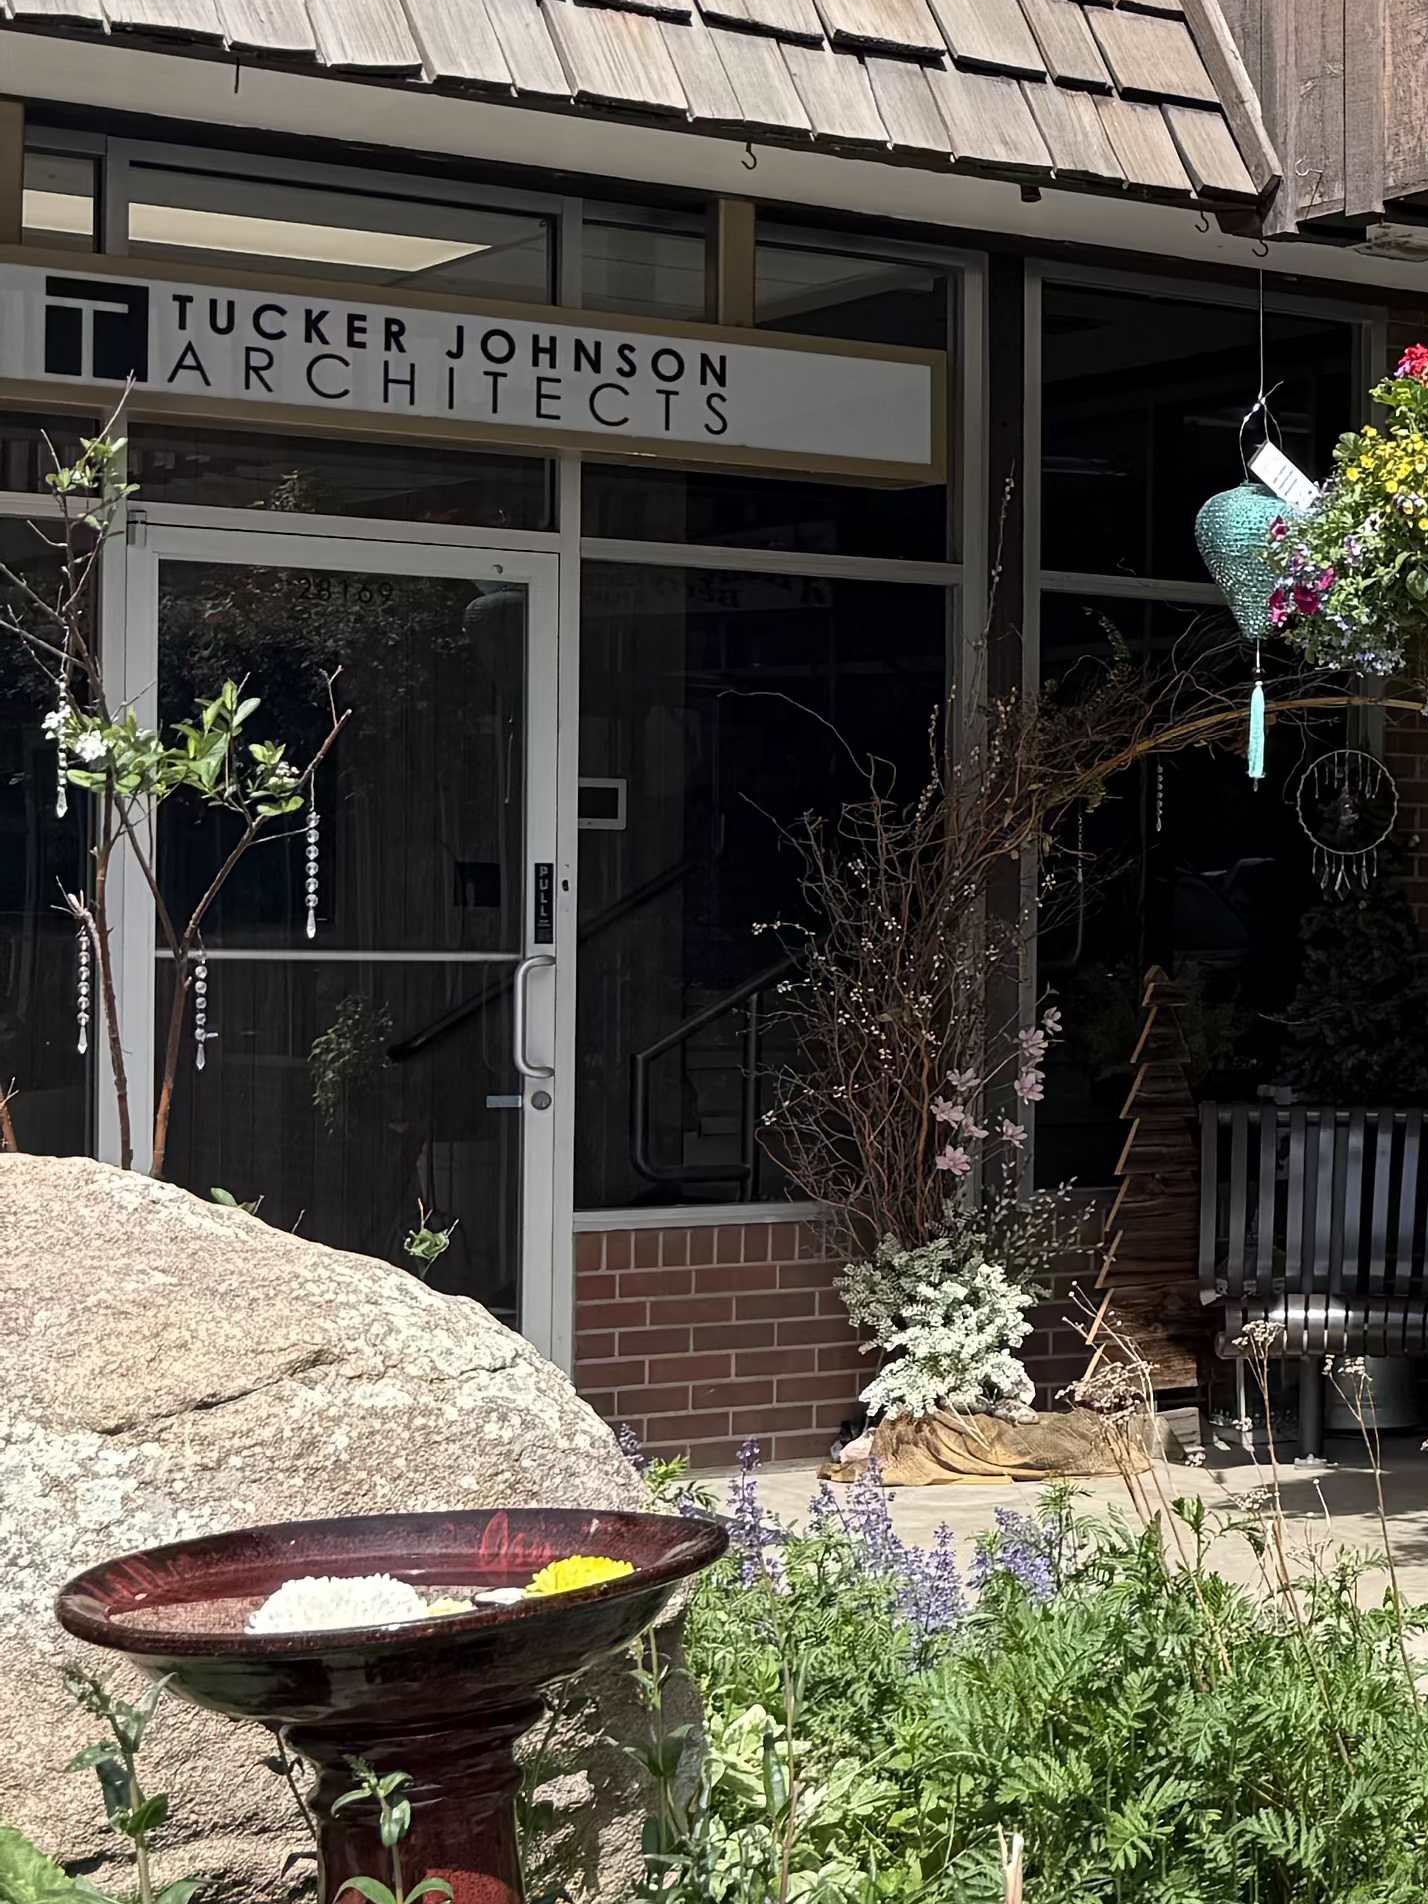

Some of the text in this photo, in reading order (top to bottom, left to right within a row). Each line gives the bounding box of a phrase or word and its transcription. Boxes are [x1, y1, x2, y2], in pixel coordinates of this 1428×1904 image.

[171, 293, 729, 389] TUCKER JOHNSON
[167, 339, 729, 436] ARCHITECTS
[297, 576, 394, 607] 28169
[538, 865, 550, 917] PULL
